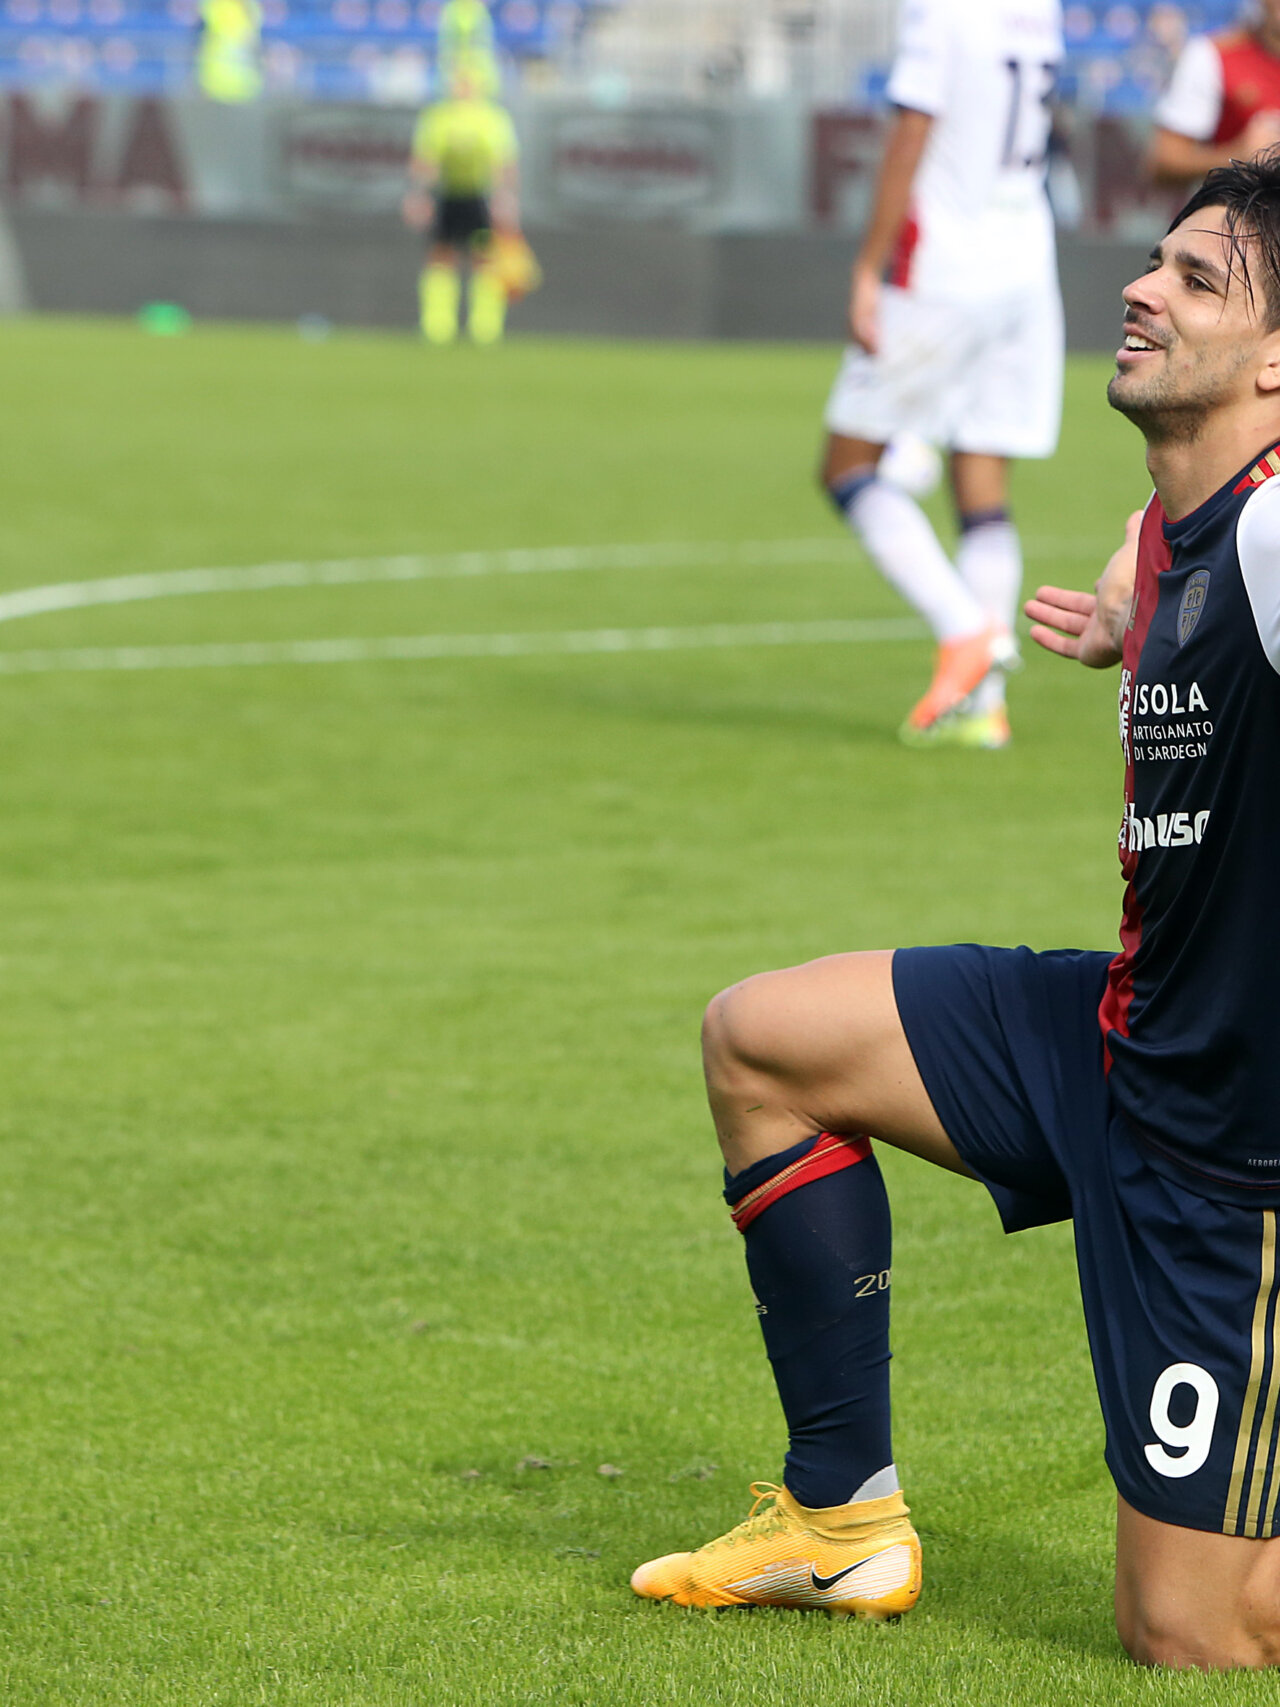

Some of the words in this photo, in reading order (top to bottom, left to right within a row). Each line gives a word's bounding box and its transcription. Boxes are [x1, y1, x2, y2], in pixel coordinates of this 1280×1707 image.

[1132, 681, 1210, 716] ISOLA
[1132, 720, 1214, 741] ARTIGIANATO
[1134, 746, 1145, 761] DI
[1143, 1361, 1220, 1479] 9
